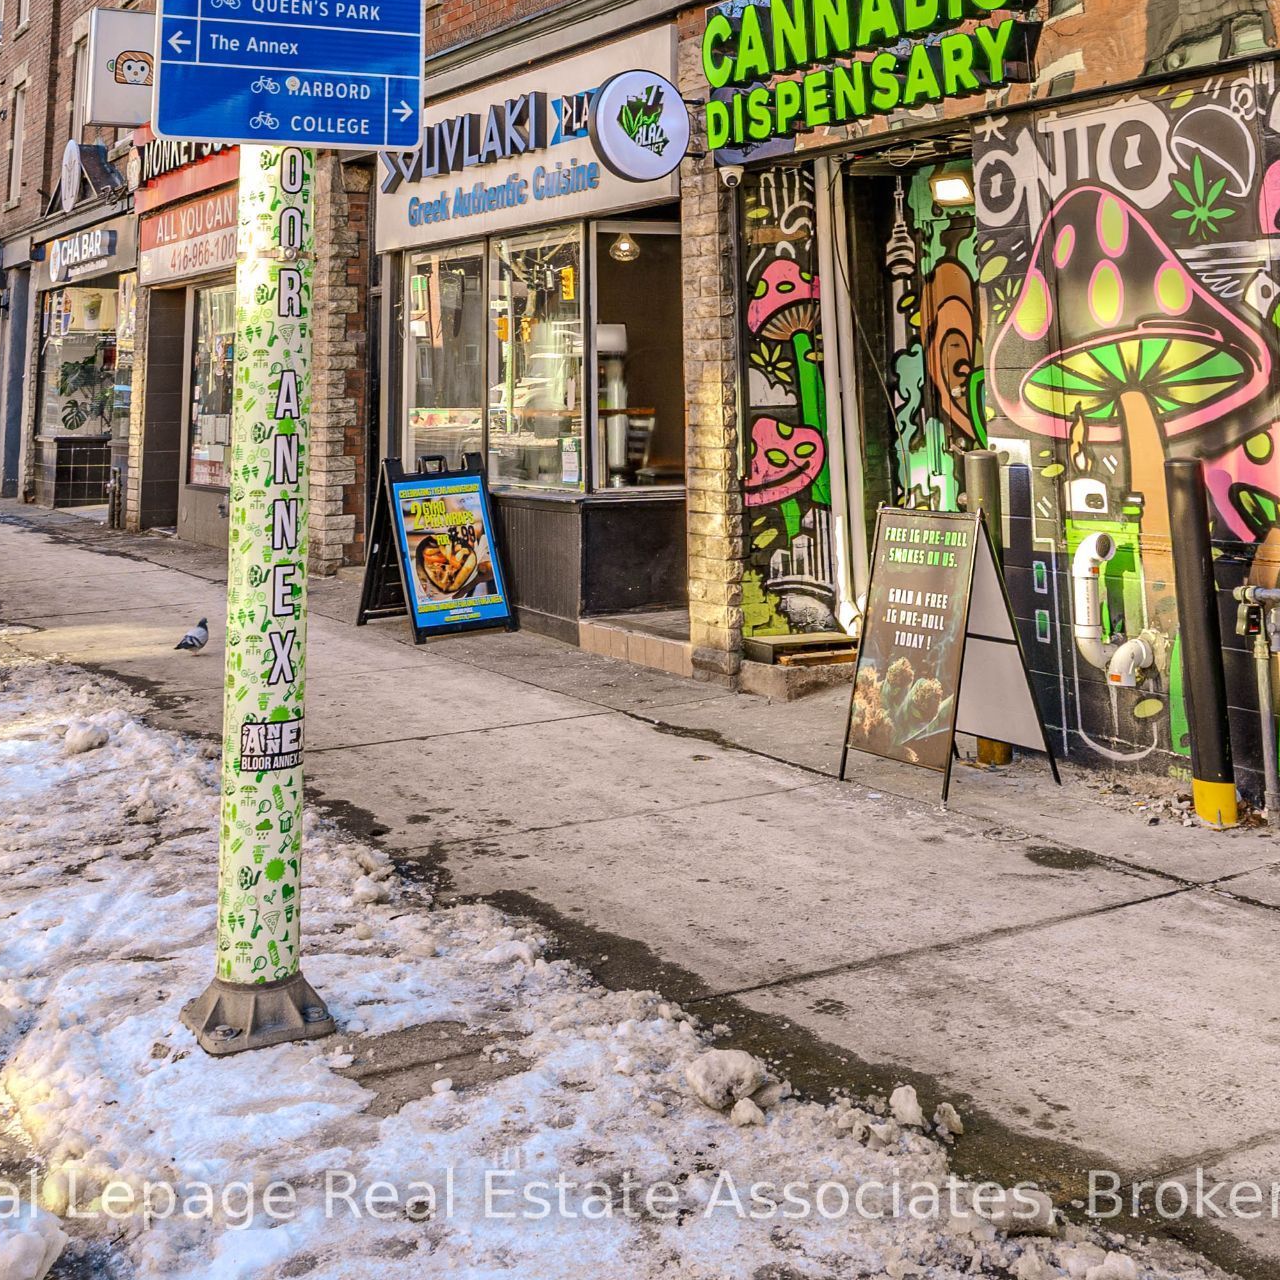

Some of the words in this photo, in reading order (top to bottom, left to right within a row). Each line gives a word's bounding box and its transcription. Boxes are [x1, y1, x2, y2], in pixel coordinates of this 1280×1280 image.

[335, 3, 381, 21] PARK
[210, 34, 241, 52] The
[246, 37, 299, 56] Annex
[706, 21, 1013, 151] DISPENSARY
[290, 115, 371, 136] COLLEGE
[561, 94, 589, 137] PLA
[408, 191, 451, 227] Greek
[452, 172, 529, 219] Authentic
[532, 158, 600, 201] Cuisine
[156, 217, 178, 244] ALL
[180, 204, 203, 235] YOU
[206, 195, 233, 229] CAN
[277, 146, 304, 318] OOR
[61, 231, 80, 267] CHÁ
[81, 229, 101, 261] BAR
[410, 501, 425, 530] 2
[422, 500, 446, 517] GYRO
[424, 514, 444, 529] PITA
[443, 510, 475, 526] WRAPS
[884, 527, 907, 543] FREE
[922, 529, 968, 548] PRE-ROLL
[888, 549, 925, 565] SMOKES
[927, 550, 940, 566] ON
[888, 587, 914, 606] GRAB
[915, 589, 923, 606] A
[924, 590, 949, 610] FREE
[899, 609, 944, 631] PRE-ROLL
[894, 630, 924, 649] TODAY
[241, 756, 272, 770] BLOOR
[272, 753, 299, 769] ANNEX
